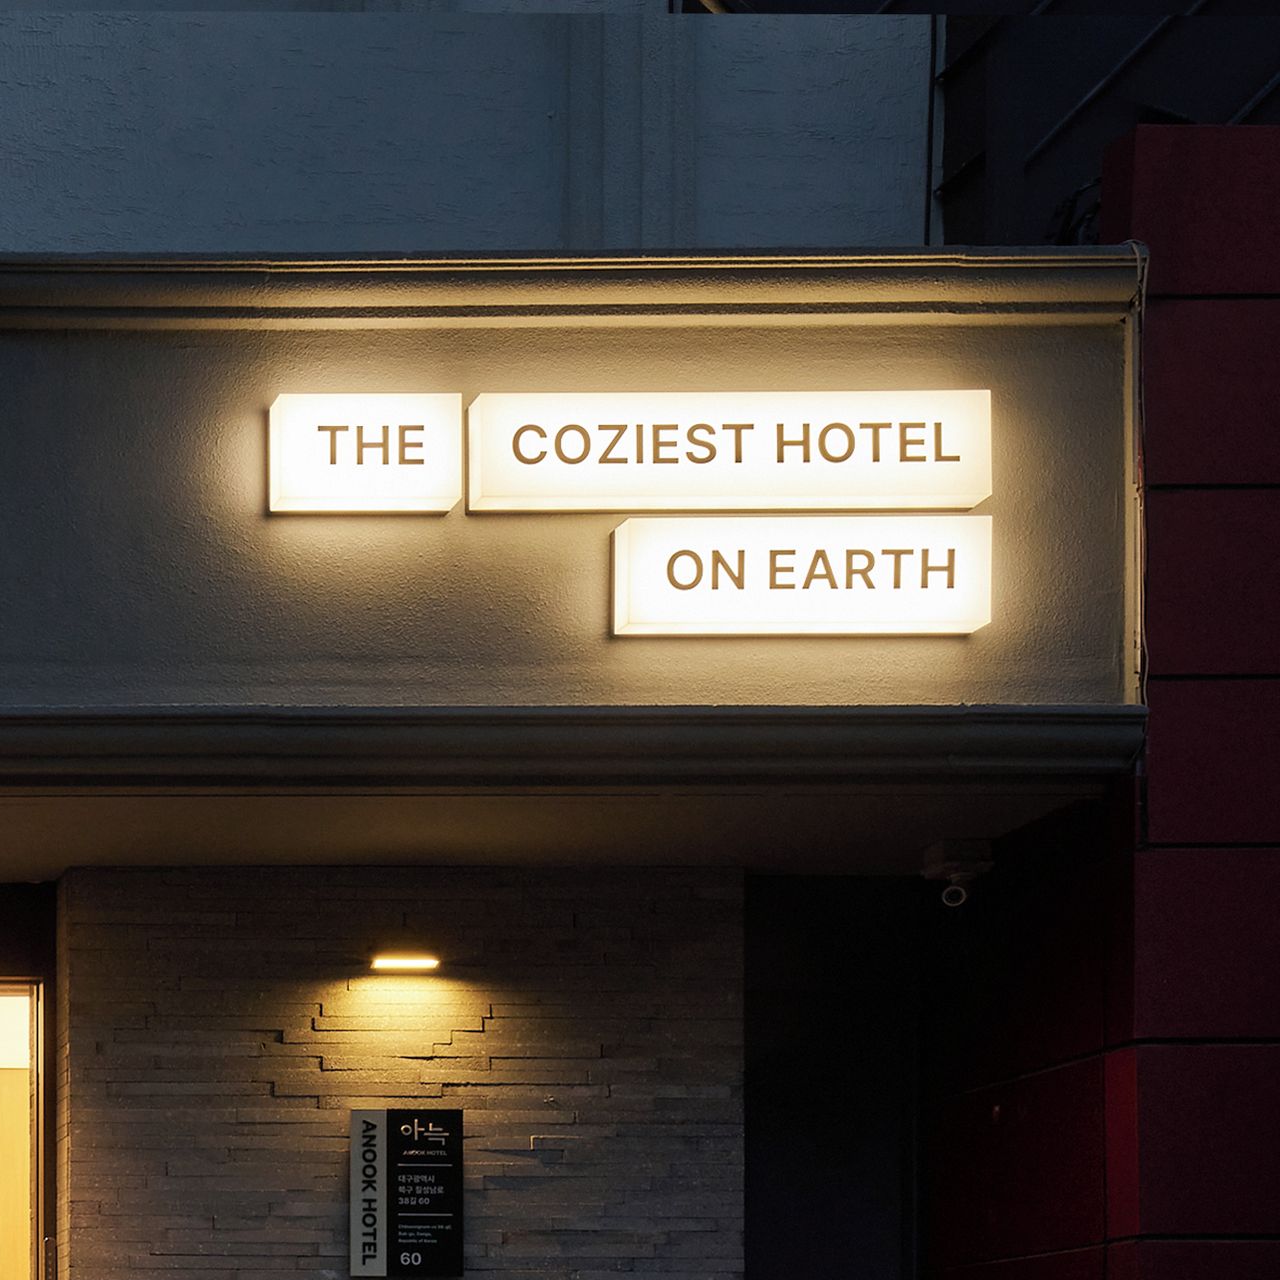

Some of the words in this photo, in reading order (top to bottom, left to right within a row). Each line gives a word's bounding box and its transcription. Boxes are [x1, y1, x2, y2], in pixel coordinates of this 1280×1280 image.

[317, 424, 425, 466] THE
[512, 423, 755, 465] COZIEST
[776, 421, 961, 464] HOTEL
[666, 549, 746, 591] ON
[768, 548, 956, 590] EARTH
[400, 1118, 450, 1146] 아늑
[361, 1119, 378, 1193] ANOOK
[361, 1198, 378, 1266] HOTEL
[400, 1252, 422, 1266] 60
